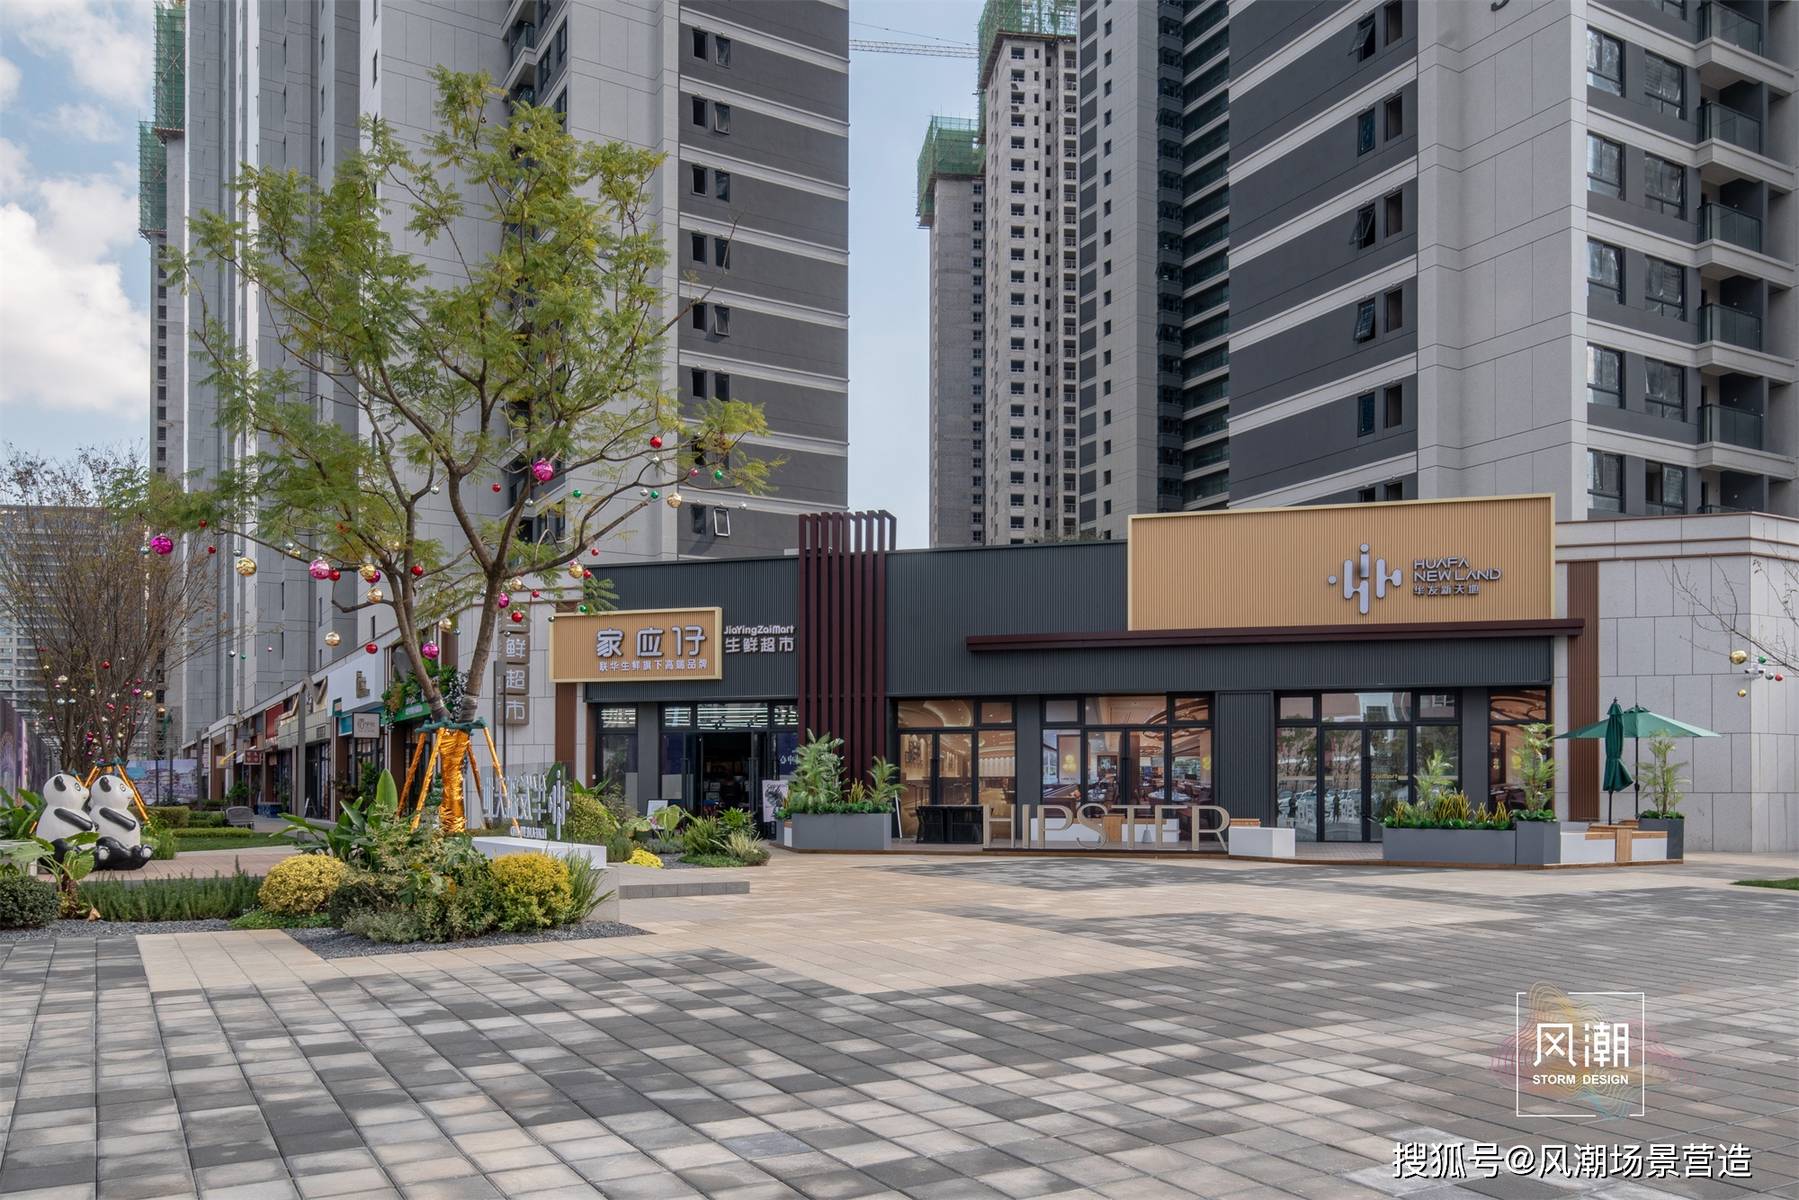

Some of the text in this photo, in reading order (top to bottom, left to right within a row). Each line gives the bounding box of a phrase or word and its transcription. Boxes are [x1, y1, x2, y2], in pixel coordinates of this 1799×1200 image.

[1413, 557, 1470, 570] HUAFA
[1413, 584, 1480, 596] 华发新天地
[724, 625, 795, 636] JiaYingZaiMart
[596, 626, 706, 658] 家应仔
[725, 636, 795, 654] 生鲜超市
[983, 803, 1231, 852] HIPSTER
